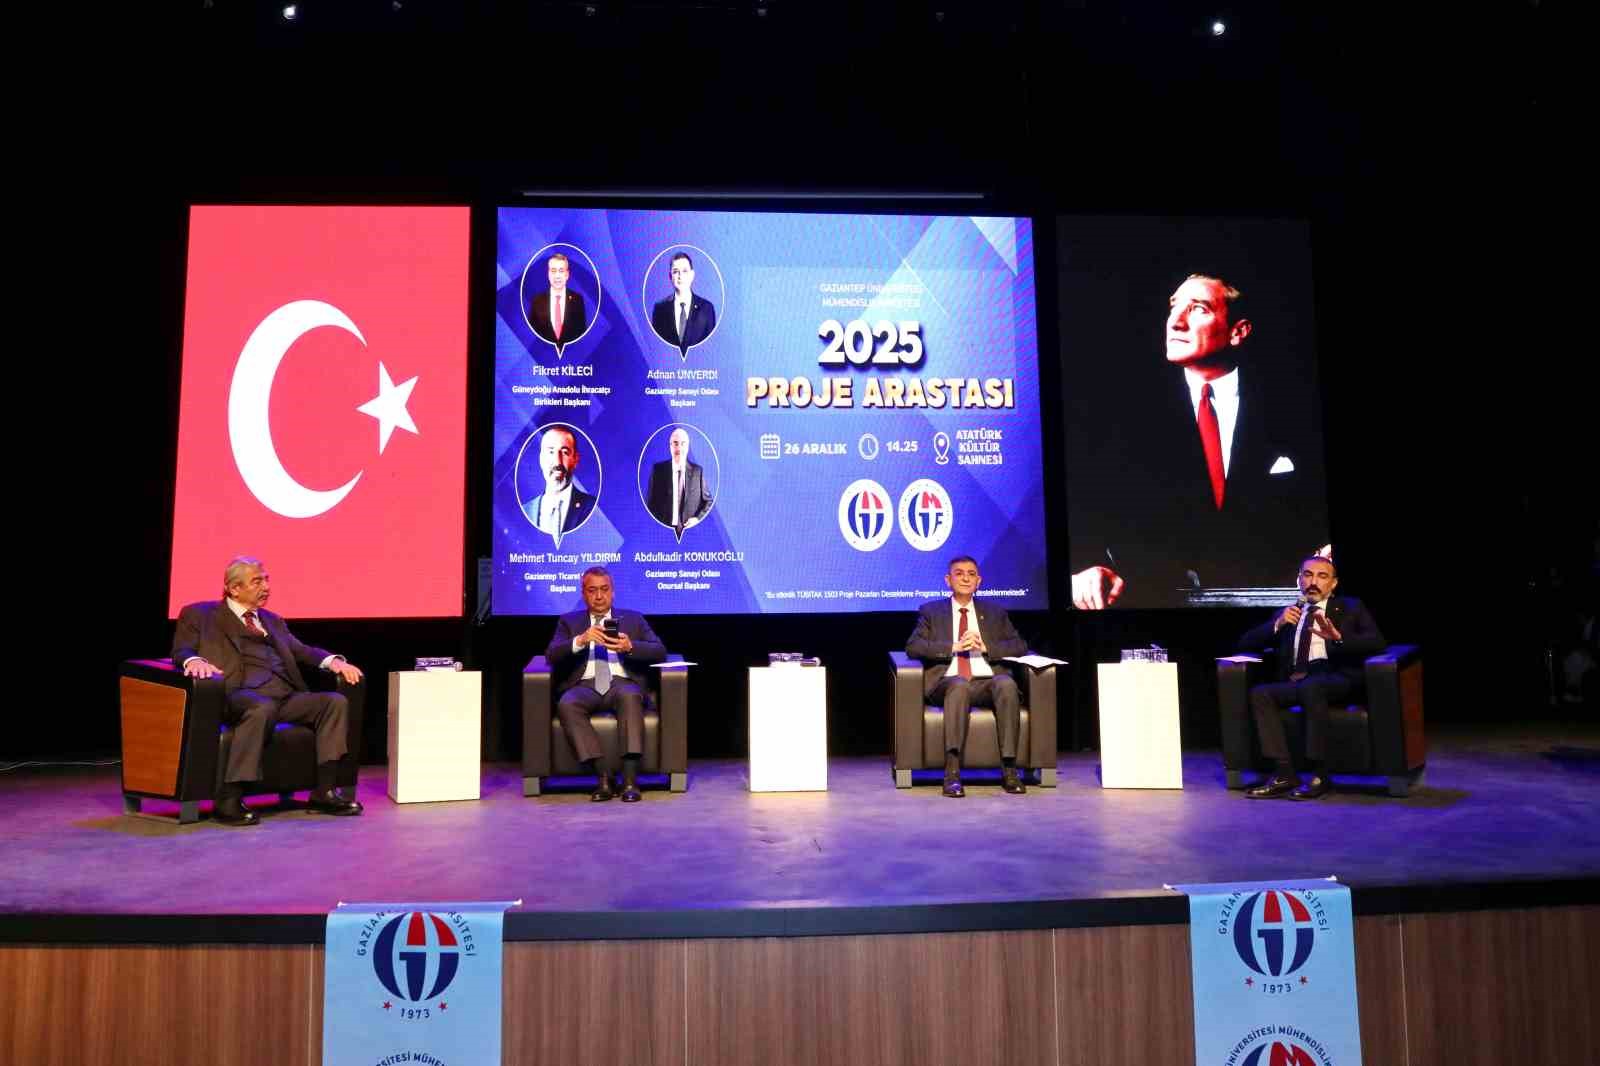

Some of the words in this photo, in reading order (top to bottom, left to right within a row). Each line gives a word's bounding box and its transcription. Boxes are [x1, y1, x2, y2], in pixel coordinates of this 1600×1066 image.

[818, 319, 924, 366] 2025
[533, 365, 560, 376] Fikret
[561, 363, 593, 376] KİLECİ
[647, 369, 675, 379] Adnan
[512, 385, 552, 395] Güneydoğu
[552, 385, 580, 394] Anadolu
[747, 376, 854, 408] PROJE
[862, 377, 1015, 408] ARASTASI
[956, 428, 1002, 439] ATATÜRK
[784, 443, 800, 454] 26
[802, 443, 848, 454] ARALIK
[886, 440, 918, 452] 14.25
[959, 440, 1000, 452] KÜLTÜR
[958, 453, 1002, 464] SAHNESİ
[509, 552, 545, 563] Mehmet
[547, 552, 578, 565] Tuncay
[580, 553, 621, 562] YILDIRIM
[634, 552, 682, 562] Abdulkadir
[684, 550, 744, 561] KONUKOĞLU
[524, 572, 556, 581] Gaziantep
[558, 572, 580, 580] Ticaret
[645, 570, 678, 578] Gaziantep
[679, 570, 700, 579] Sanayi
[657, 582, 682, 590] Onursal
[1263, 983, 1292, 994] 1973
[401, 1008, 430, 1019] 1973
